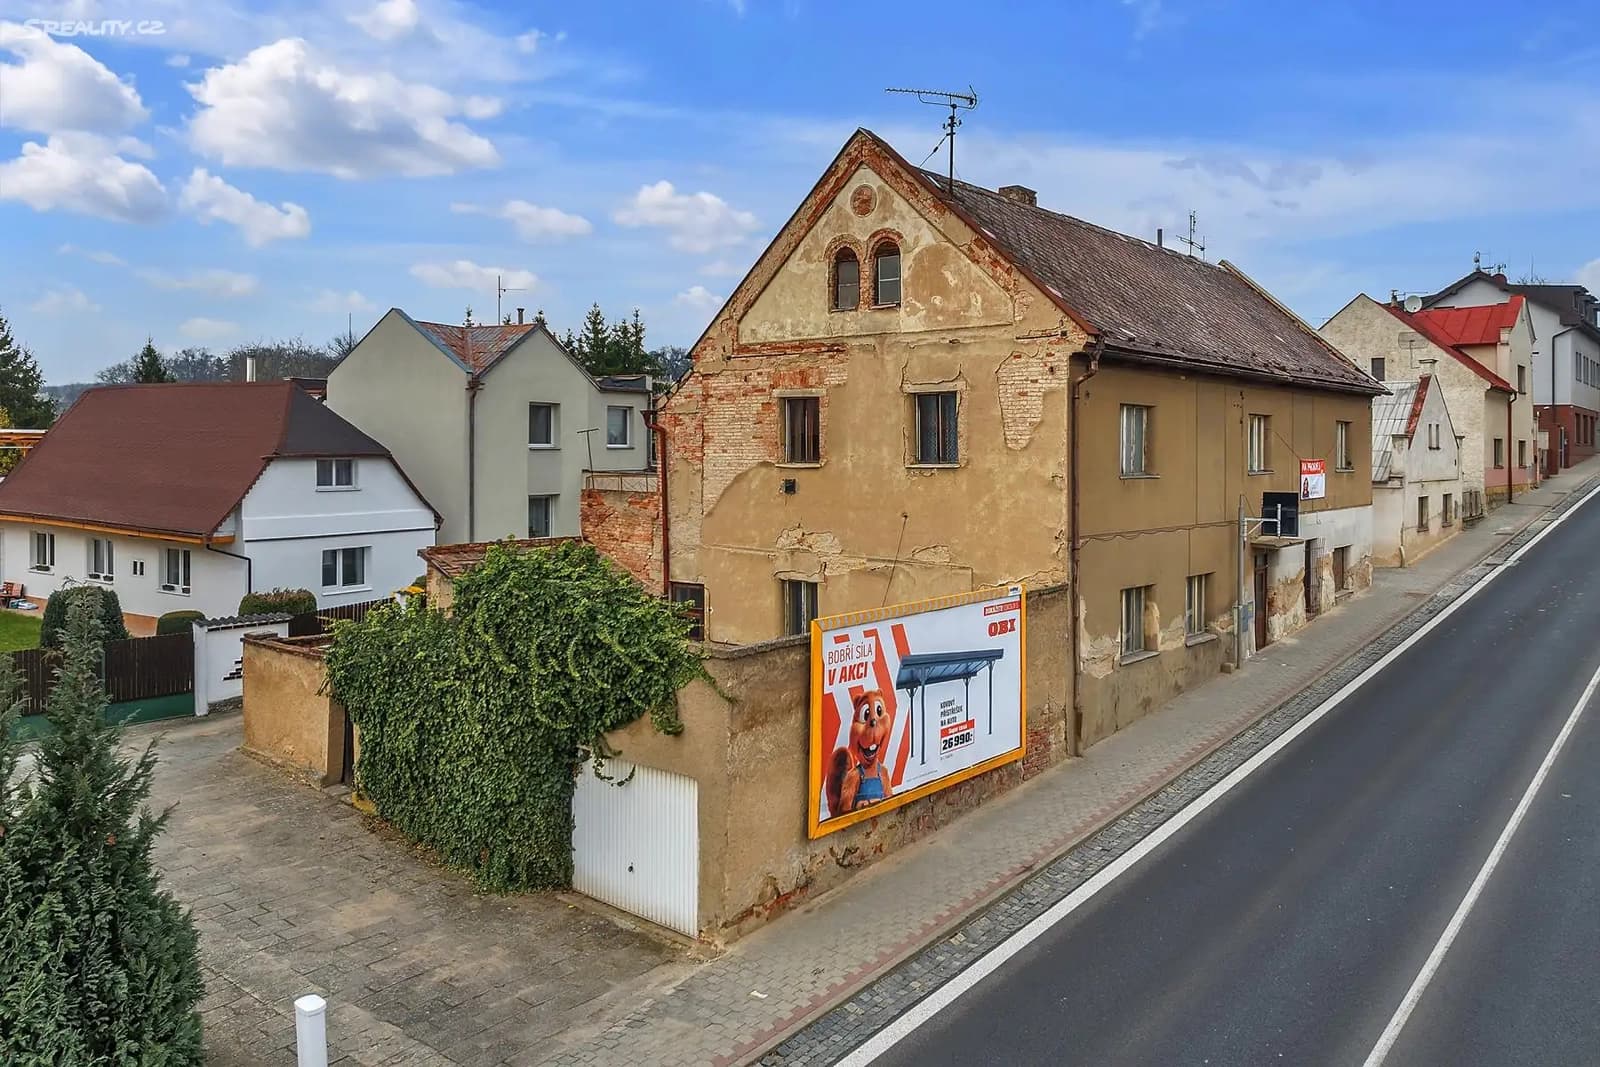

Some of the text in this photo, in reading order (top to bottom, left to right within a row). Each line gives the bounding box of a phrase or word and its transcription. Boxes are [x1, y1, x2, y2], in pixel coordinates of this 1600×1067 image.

[988, 618, 1016, 637] OBI
[828, 641, 873, 665] BOBŘÍ SÍLA
[828, 661, 869, 686] V AKCI
